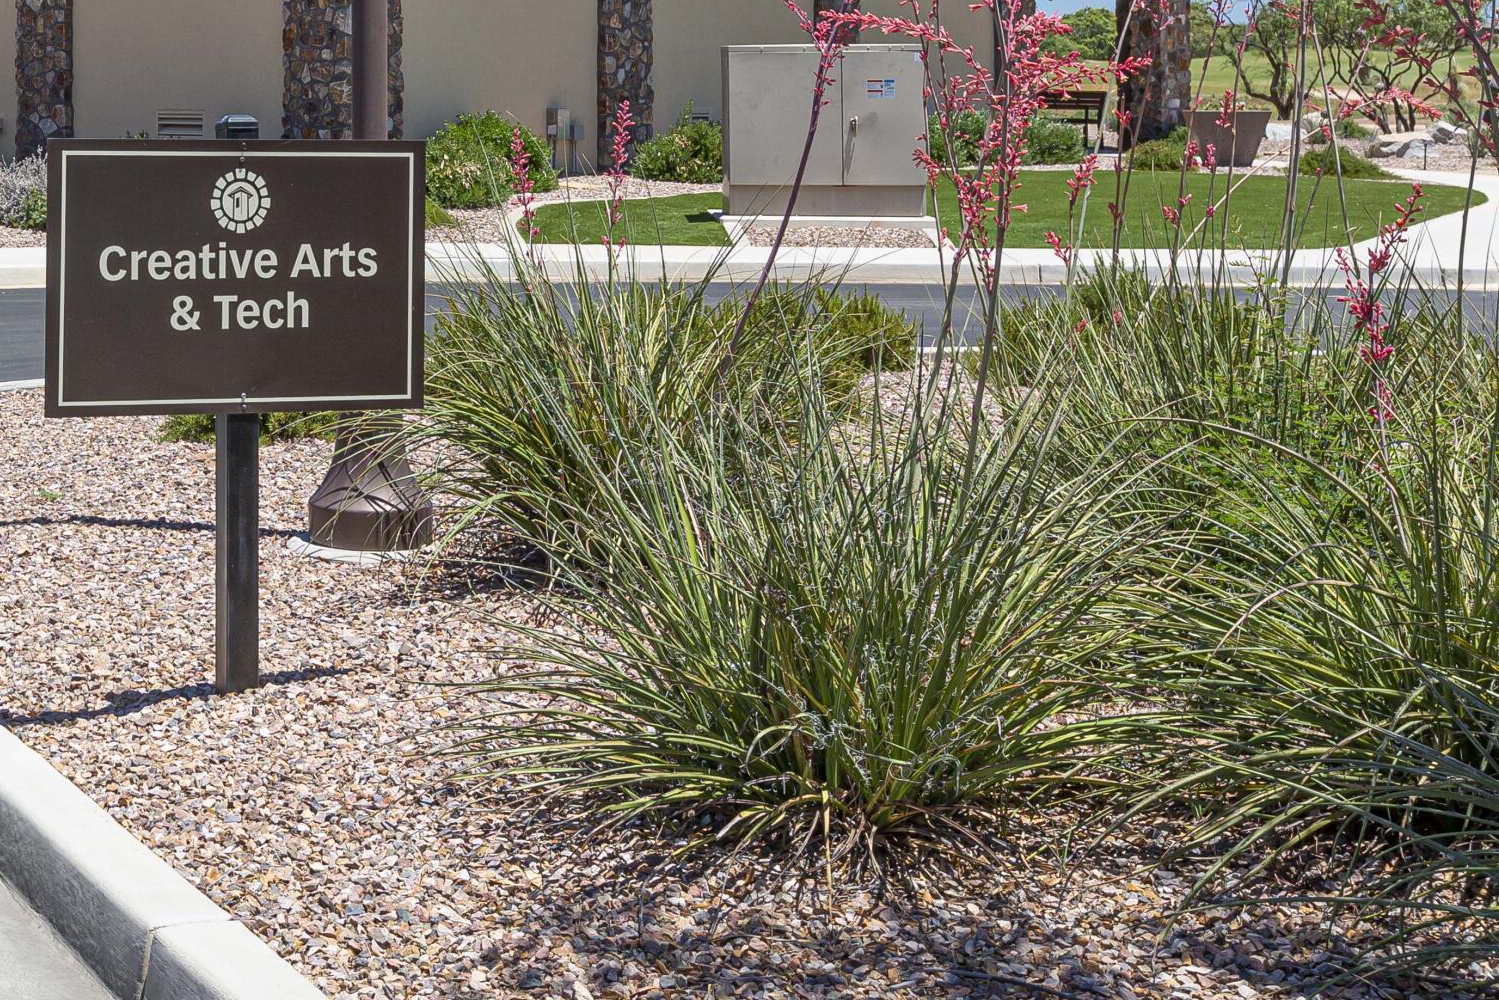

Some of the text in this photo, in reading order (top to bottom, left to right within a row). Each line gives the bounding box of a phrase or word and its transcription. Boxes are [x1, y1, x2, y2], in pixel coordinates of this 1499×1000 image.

[98, 241, 378, 282] Creative Arts
[170, 290, 309, 331] & Tech
